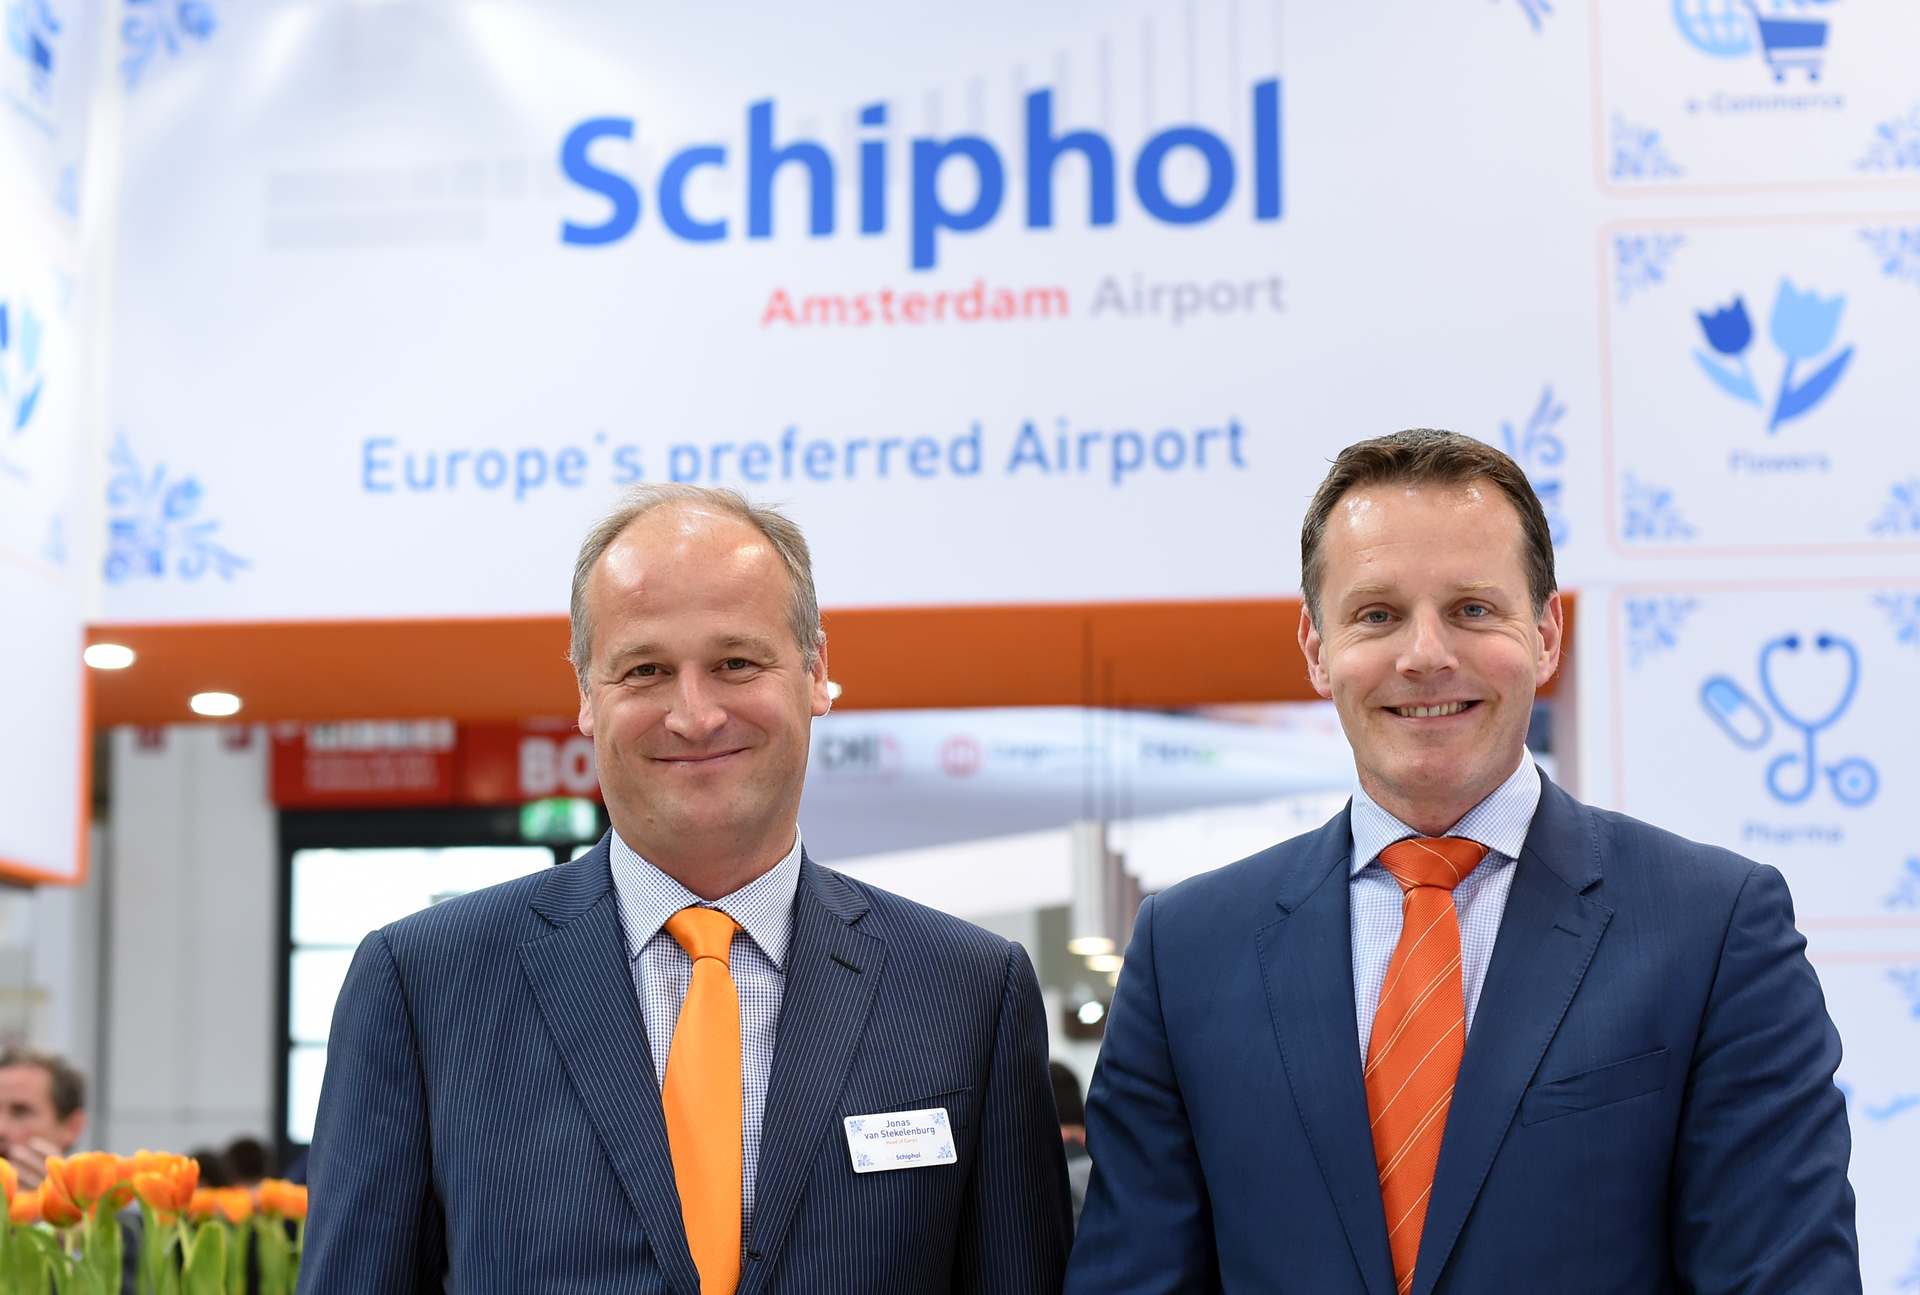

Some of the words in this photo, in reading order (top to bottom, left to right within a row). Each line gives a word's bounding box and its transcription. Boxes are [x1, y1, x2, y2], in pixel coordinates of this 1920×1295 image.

[559, 76, 1284, 270] Schiphol
[762, 278, 1070, 328] Amsterdam
[1091, 271, 1287, 326] Airport
[669, 420, 982, 485] preferred
[1006, 416, 1249, 489] Airport
[1728, 448, 1831, 476] Flowers
[864, 1131, 879, 1140] van
[880, 1126, 936, 1139] Stekelenburg
[886, 1119, 911, 1128] Jonas
[895, 1152, 921, 1160] Schiphol
